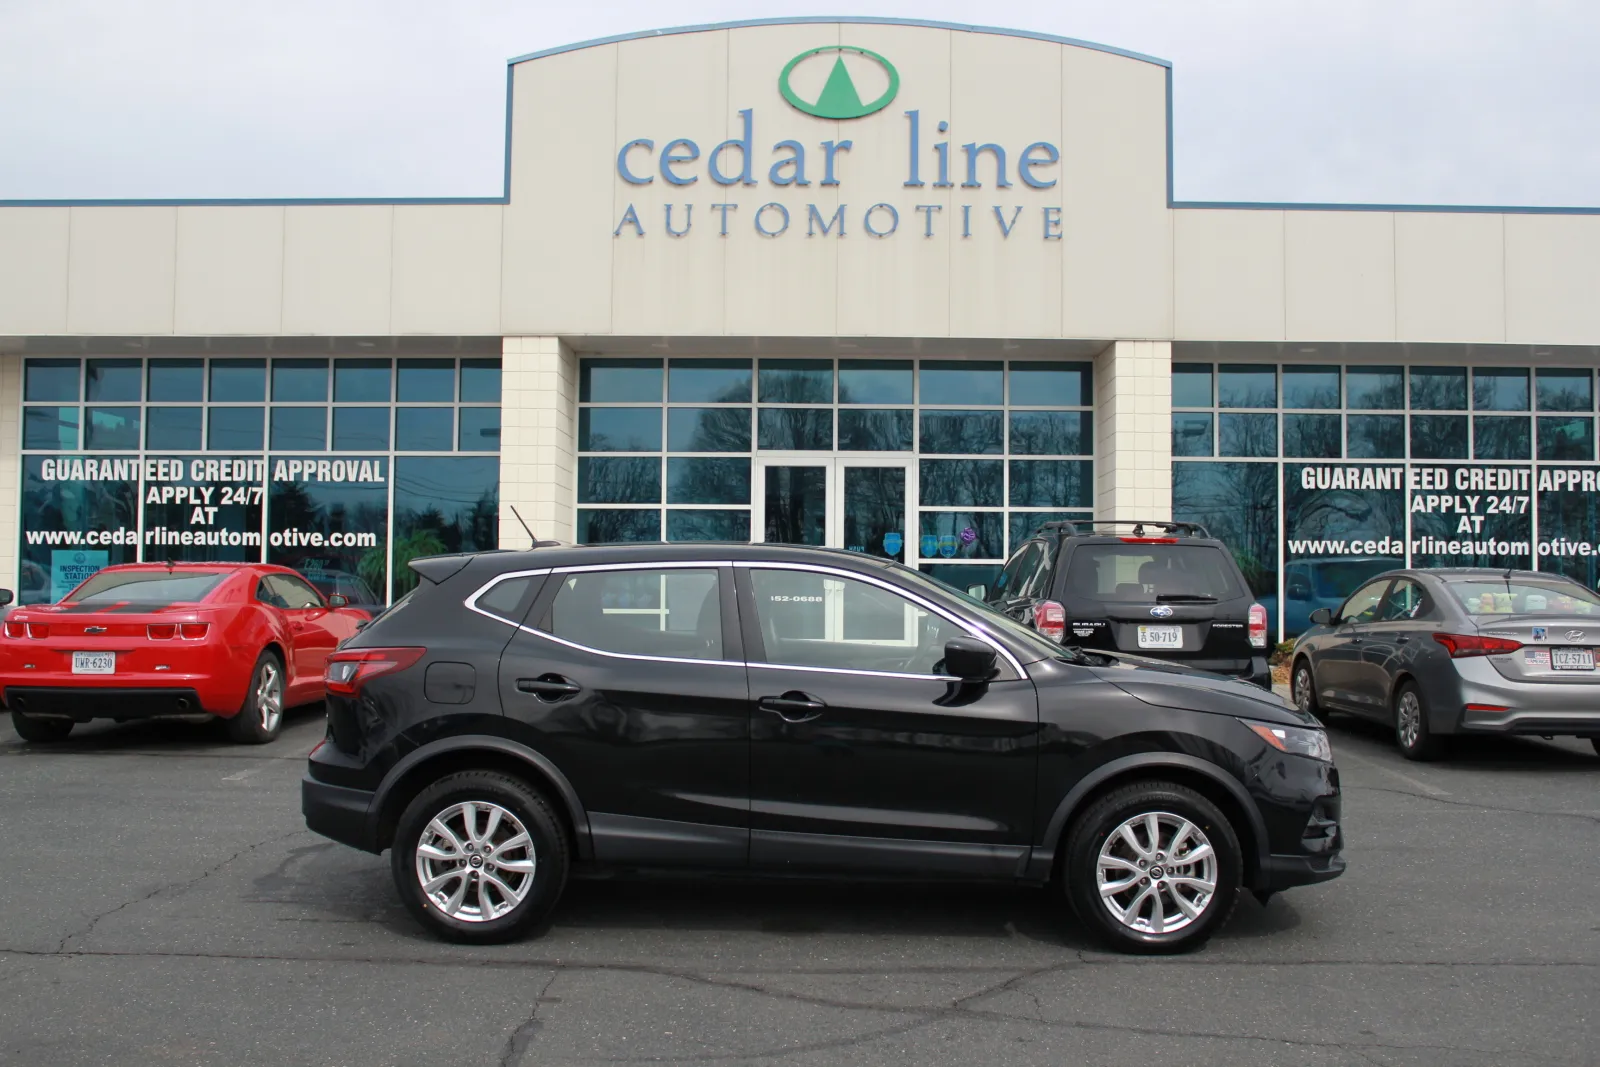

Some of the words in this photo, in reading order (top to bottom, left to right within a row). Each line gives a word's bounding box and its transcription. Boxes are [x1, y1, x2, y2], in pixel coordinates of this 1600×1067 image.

[616, 108, 853, 186] cedar
[903, 109, 1060, 189] line
[613, 201, 1063, 240] AUTOMOTIVE
[41, 459, 184, 482] GUARANTEED
[190, 460, 264, 482] CREDIT
[274, 460, 385, 483] APPROVAL
[1301, 467, 1449, 490] GUARANTEED
[1454, 468, 1531, 491] CREDIT
[146, 487, 215, 505] APPLY
[220, 487, 264, 505] 24/7
[1410, 495, 1480, 514] APPLY
[1486, 495, 1530, 514] 24/7
[190, 507, 219, 525] AT
[1457, 516, 1485, 534] AT
[26, 526, 377, 548] www.cedarlineautomotive.com
[1288, 536, 1600, 557] www.cedarlineautomotive.
[1149, 632, 1178, 643] 50-719
[1554, 653, 1592, 664] TCZ-5711
